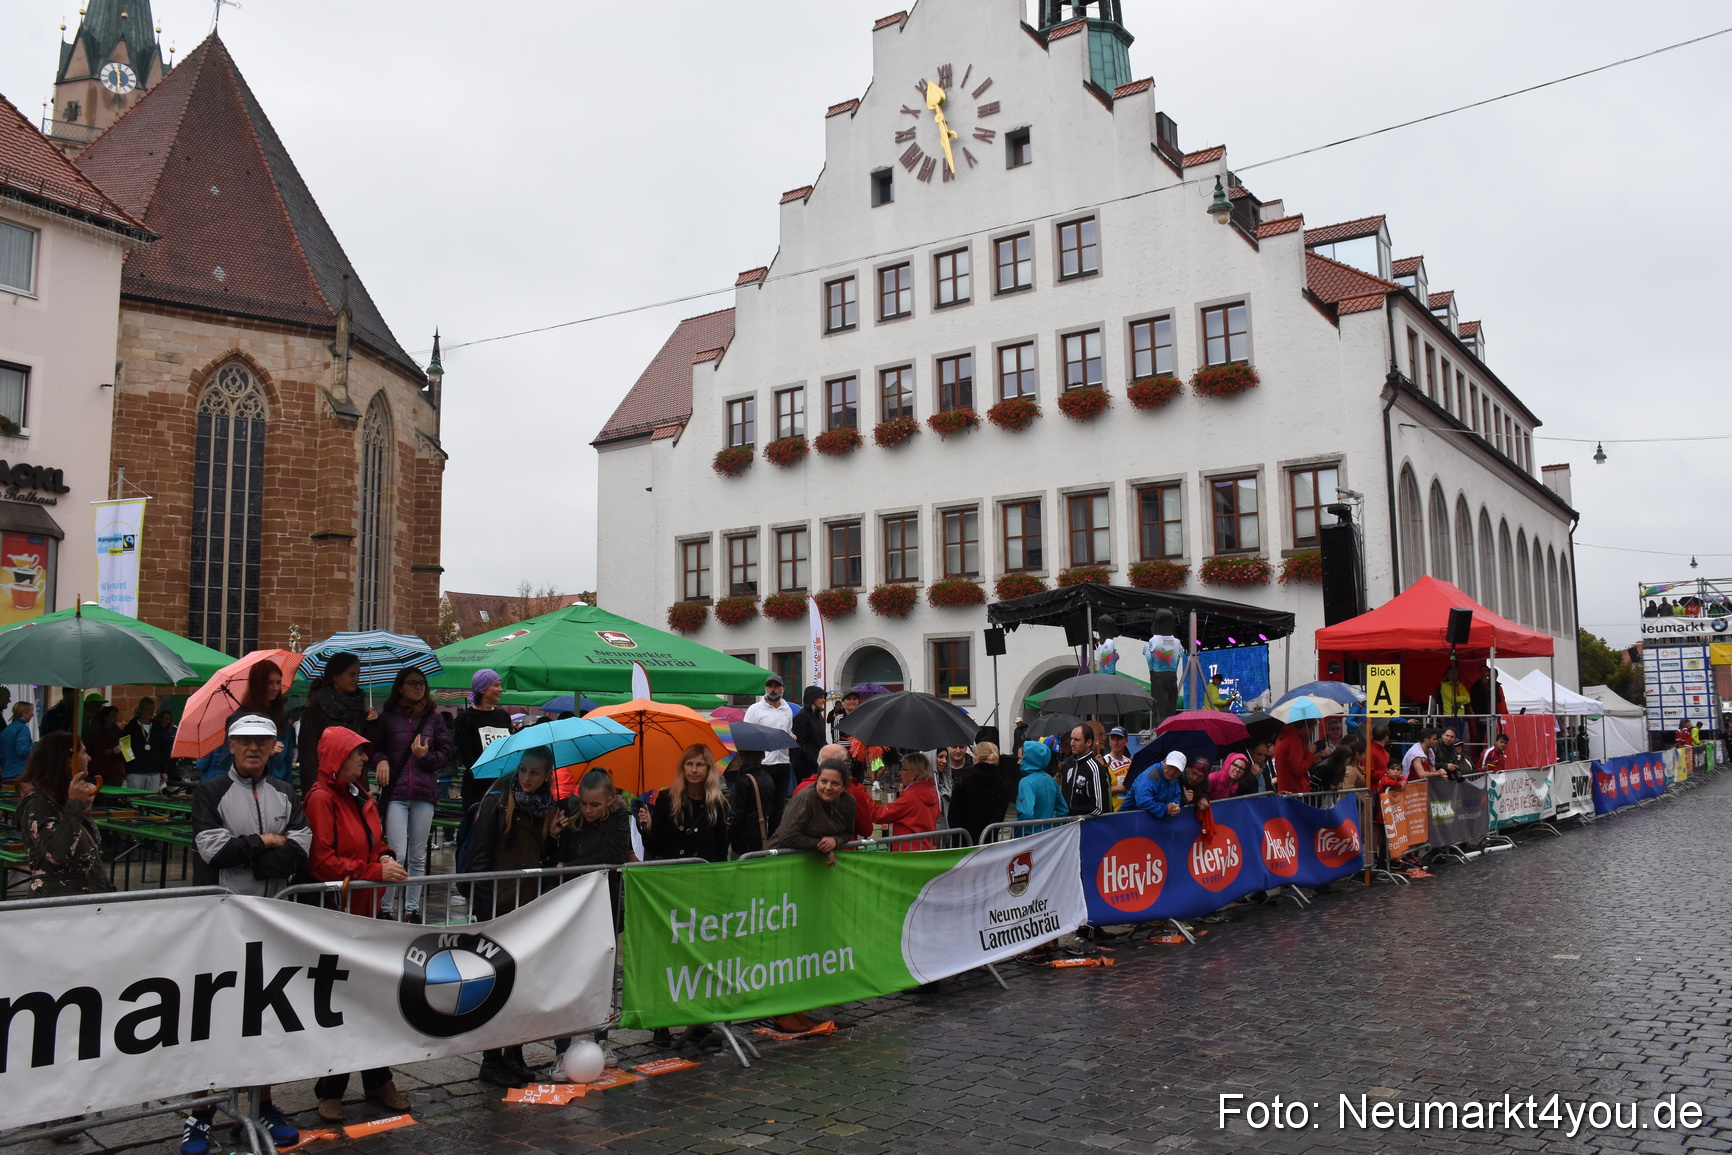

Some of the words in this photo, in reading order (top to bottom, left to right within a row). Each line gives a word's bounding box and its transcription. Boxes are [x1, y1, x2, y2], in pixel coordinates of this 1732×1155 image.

[4, 487, 58, 506] Rathaus
[1641, 621, 1705, 634] Neumarkt
[593, 649, 673, 659] Neumarkter
[1371, 667, 1396, 676] Block
[1374, 680, 1393, 706] A
[1192, 838, 1240, 878] Hervis
[1264, 830, 1296, 864] Hervis
[1317, 827, 1360, 856] Hervis
[1103, 853, 1164, 896] Hervis
[1110, 890, 1140, 905] SPORTS
[670, 893, 798, 944] Herzlich
[979, 912, 1061, 951] Lammsbräu
[406, 932, 500, 968] BMW
[666, 946, 855, 1003] Willkommen
[0, 941, 350, 1074] markt
